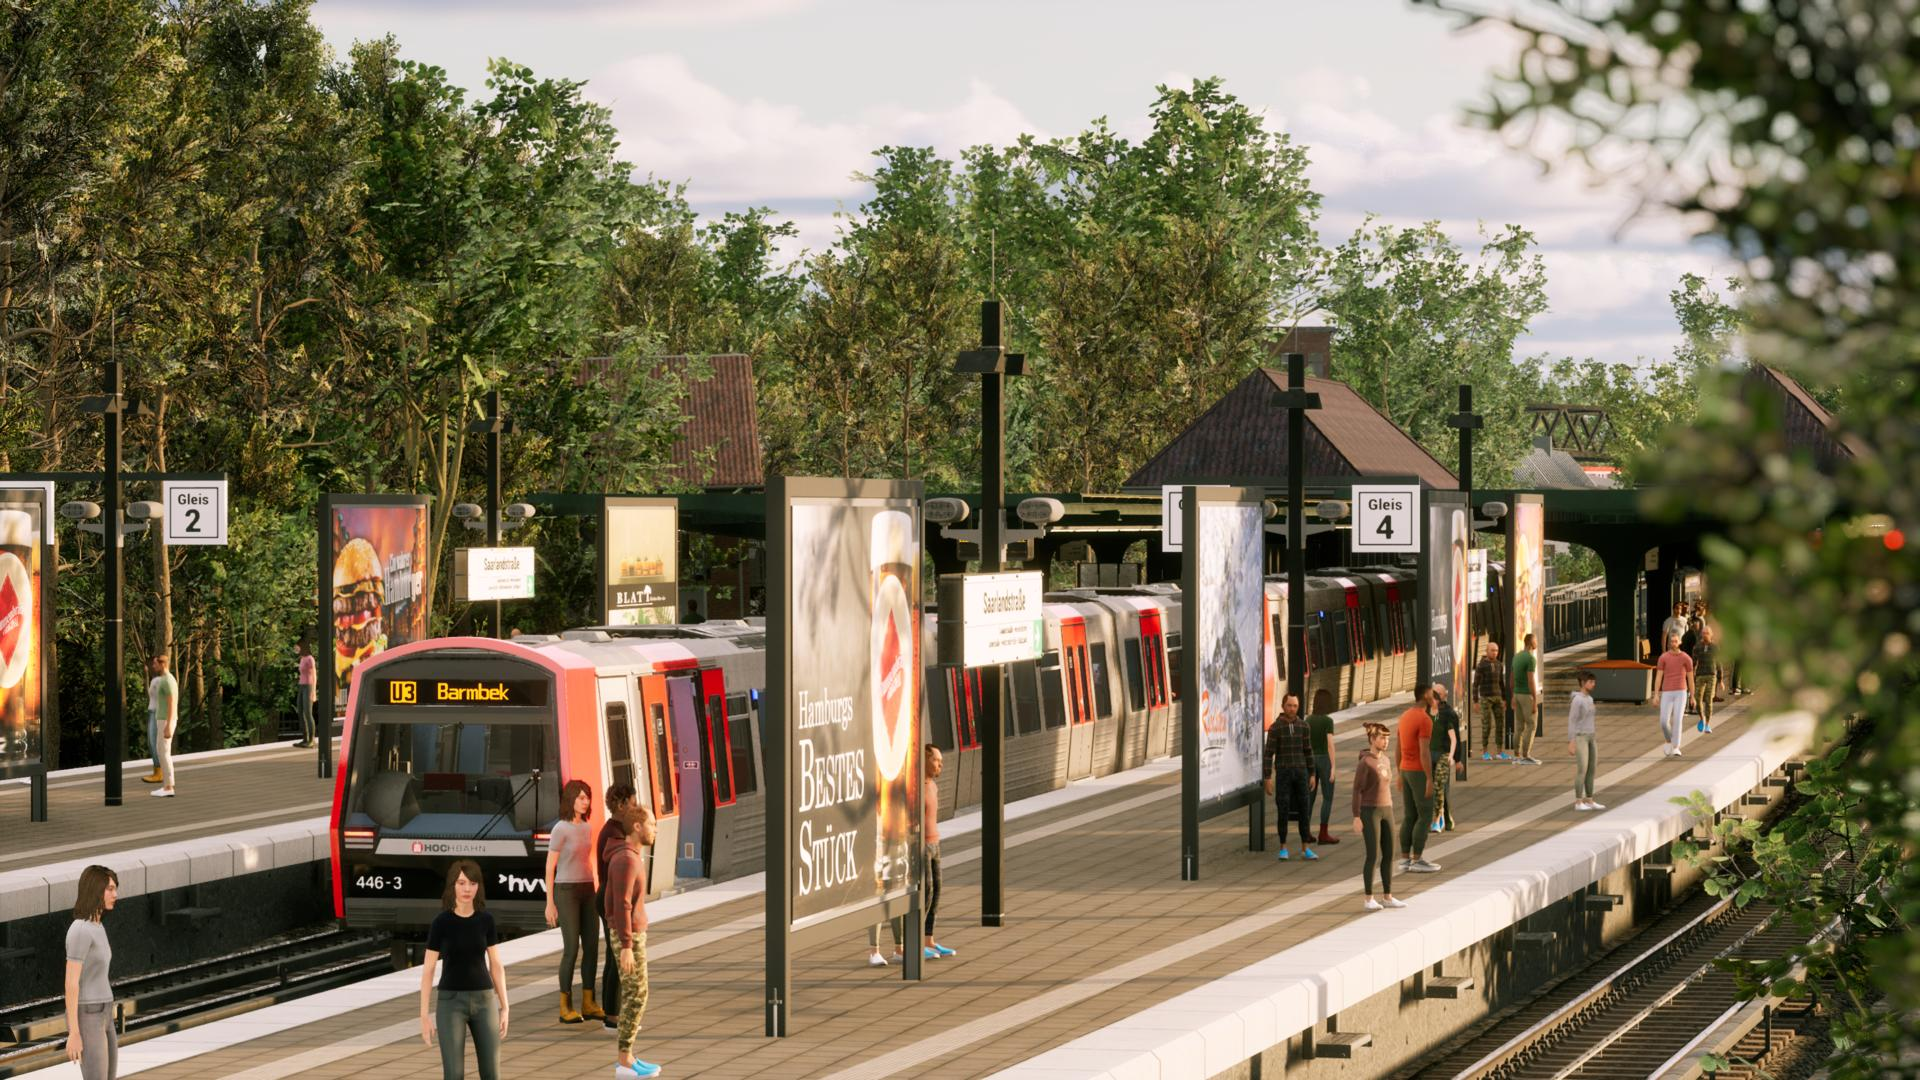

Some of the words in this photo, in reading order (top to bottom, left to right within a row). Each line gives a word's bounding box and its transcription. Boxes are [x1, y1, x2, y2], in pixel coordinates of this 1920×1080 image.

[178, 493, 209, 505] Gleis
[1368, 498, 1402, 511] Gleis
[185, 508, 201, 533] 2
[1376, 515, 1394, 540] 4
[983, 587, 1026, 614] Saarlandstraße
[390, 681, 417, 703] U3
[437, 682, 510, 701] Barmbek
[798, 687, 854, 731] Hamburgs
[798, 738, 865, 813] BESTES
[424, 843, 487, 853] HOCHBAHN
[798, 819, 859, 897] STÜCK
[356, 875, 403, 890] 446-3
